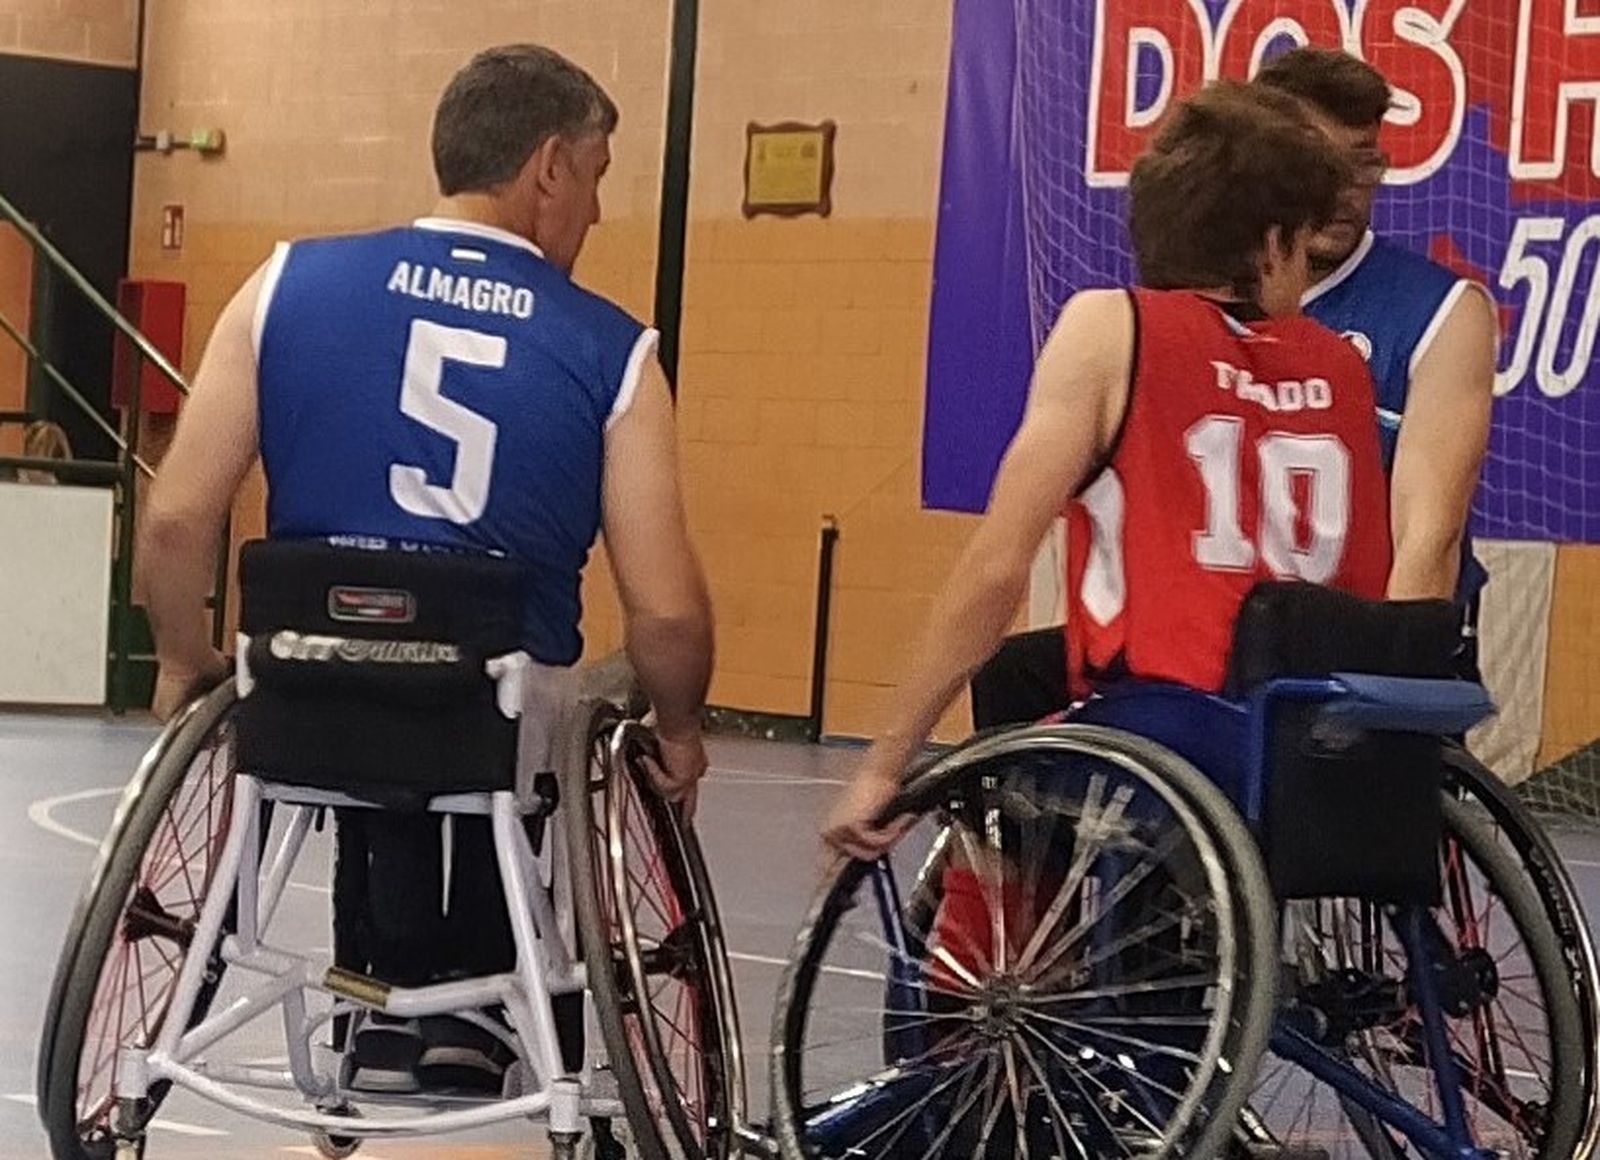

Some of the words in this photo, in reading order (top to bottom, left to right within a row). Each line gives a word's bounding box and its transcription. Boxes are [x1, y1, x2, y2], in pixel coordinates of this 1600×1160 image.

[387, 261, 534, 320] ALMAGRO
[1493, 214, 1600, 397] 50
[389, 318, 508, 524] 5
[1183, 413, 1352, 583] 10
